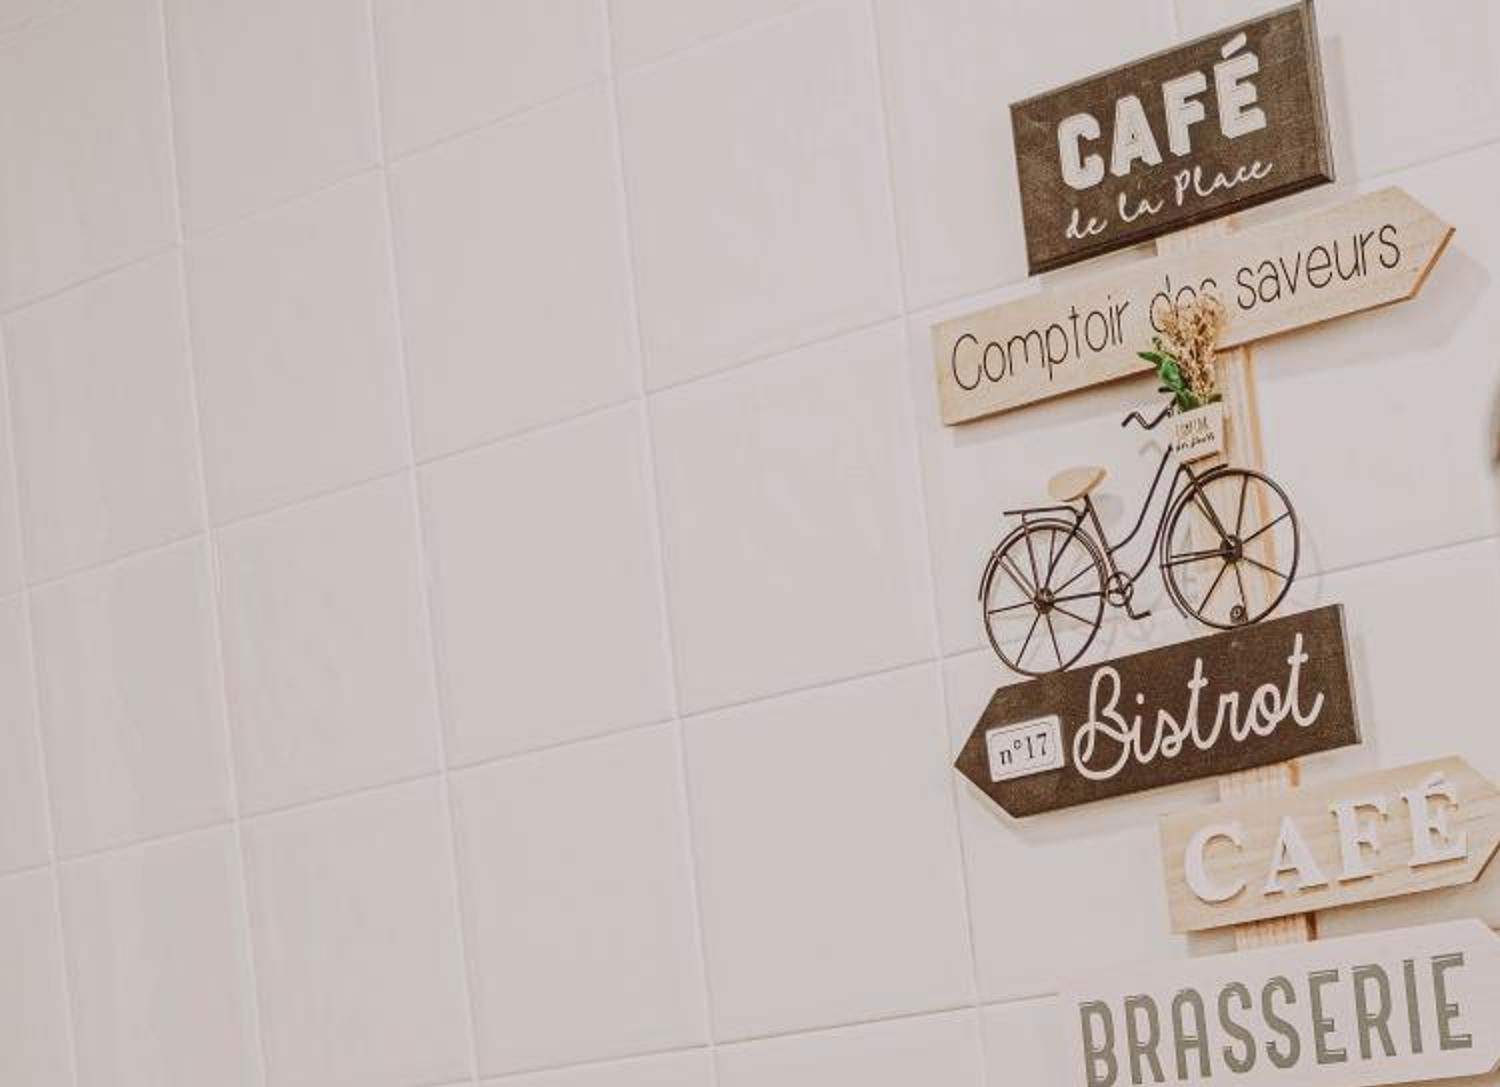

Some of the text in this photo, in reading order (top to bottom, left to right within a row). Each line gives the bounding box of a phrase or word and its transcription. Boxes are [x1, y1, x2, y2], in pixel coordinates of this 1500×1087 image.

[1057, 32, 1266, 191] CAFÉ
[1065, 160, 1273, 239] de la Place
[951, 294, 1131, 390] Comptoir
[1236, 223, 1401, 311] saveurs
[1072, 633, 1325, 781] Bistrot
[1183, 772, 1470, 904] CAFÉ
